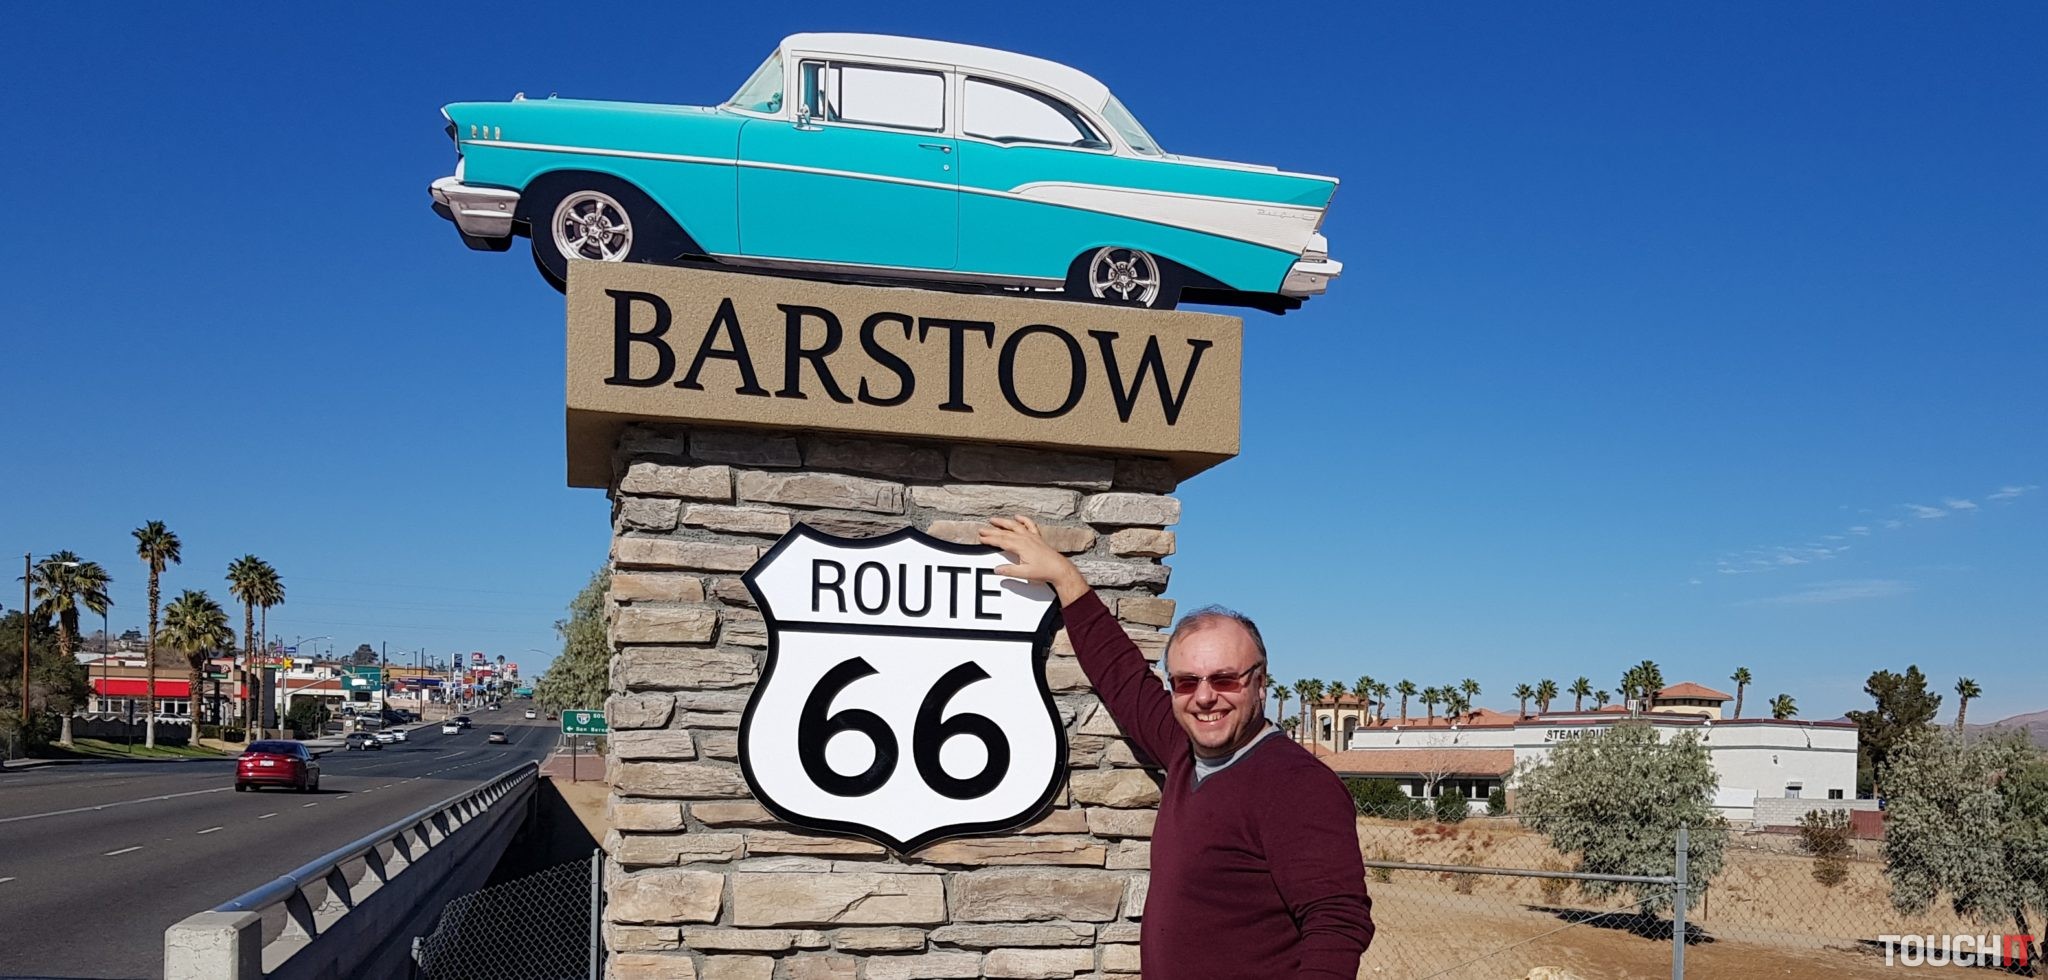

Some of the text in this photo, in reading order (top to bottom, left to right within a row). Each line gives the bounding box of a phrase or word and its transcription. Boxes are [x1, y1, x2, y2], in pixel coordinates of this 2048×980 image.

[604, 289, 1213, 426] BARSTOW
[811, 559, 1002, 620] ROUTE
[798, 656, 1010, 800] 66
